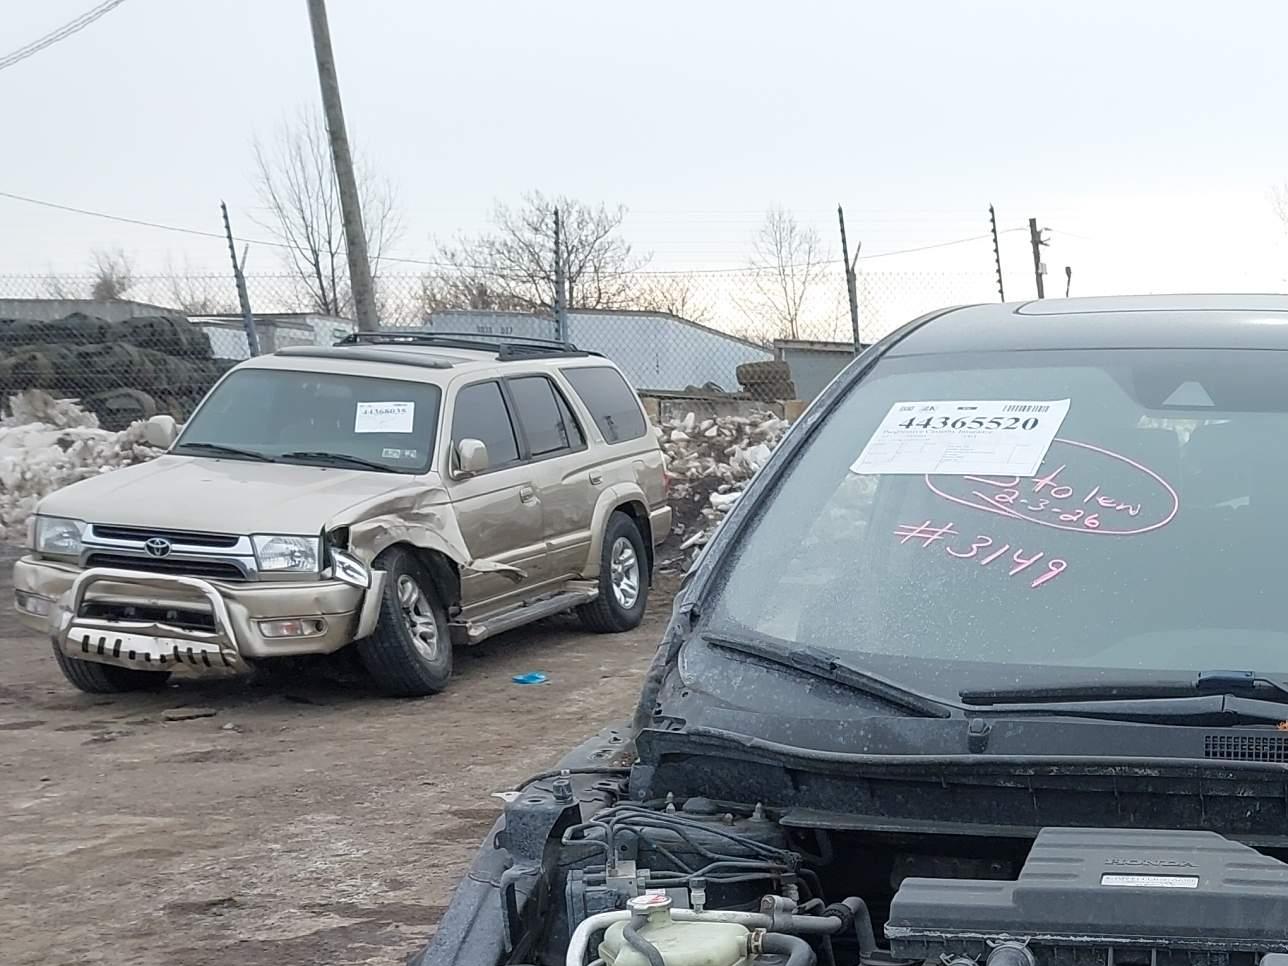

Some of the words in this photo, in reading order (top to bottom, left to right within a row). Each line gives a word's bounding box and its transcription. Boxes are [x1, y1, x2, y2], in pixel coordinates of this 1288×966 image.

[898, 416, 1039, 430] 44365520
[963, 464, 1141, 516] tolen
[995, 488, 1100, 529] 2-3-26
[893, 520, 1068, 588] #3149
[1104, 857, 1199, 867] HONDA
